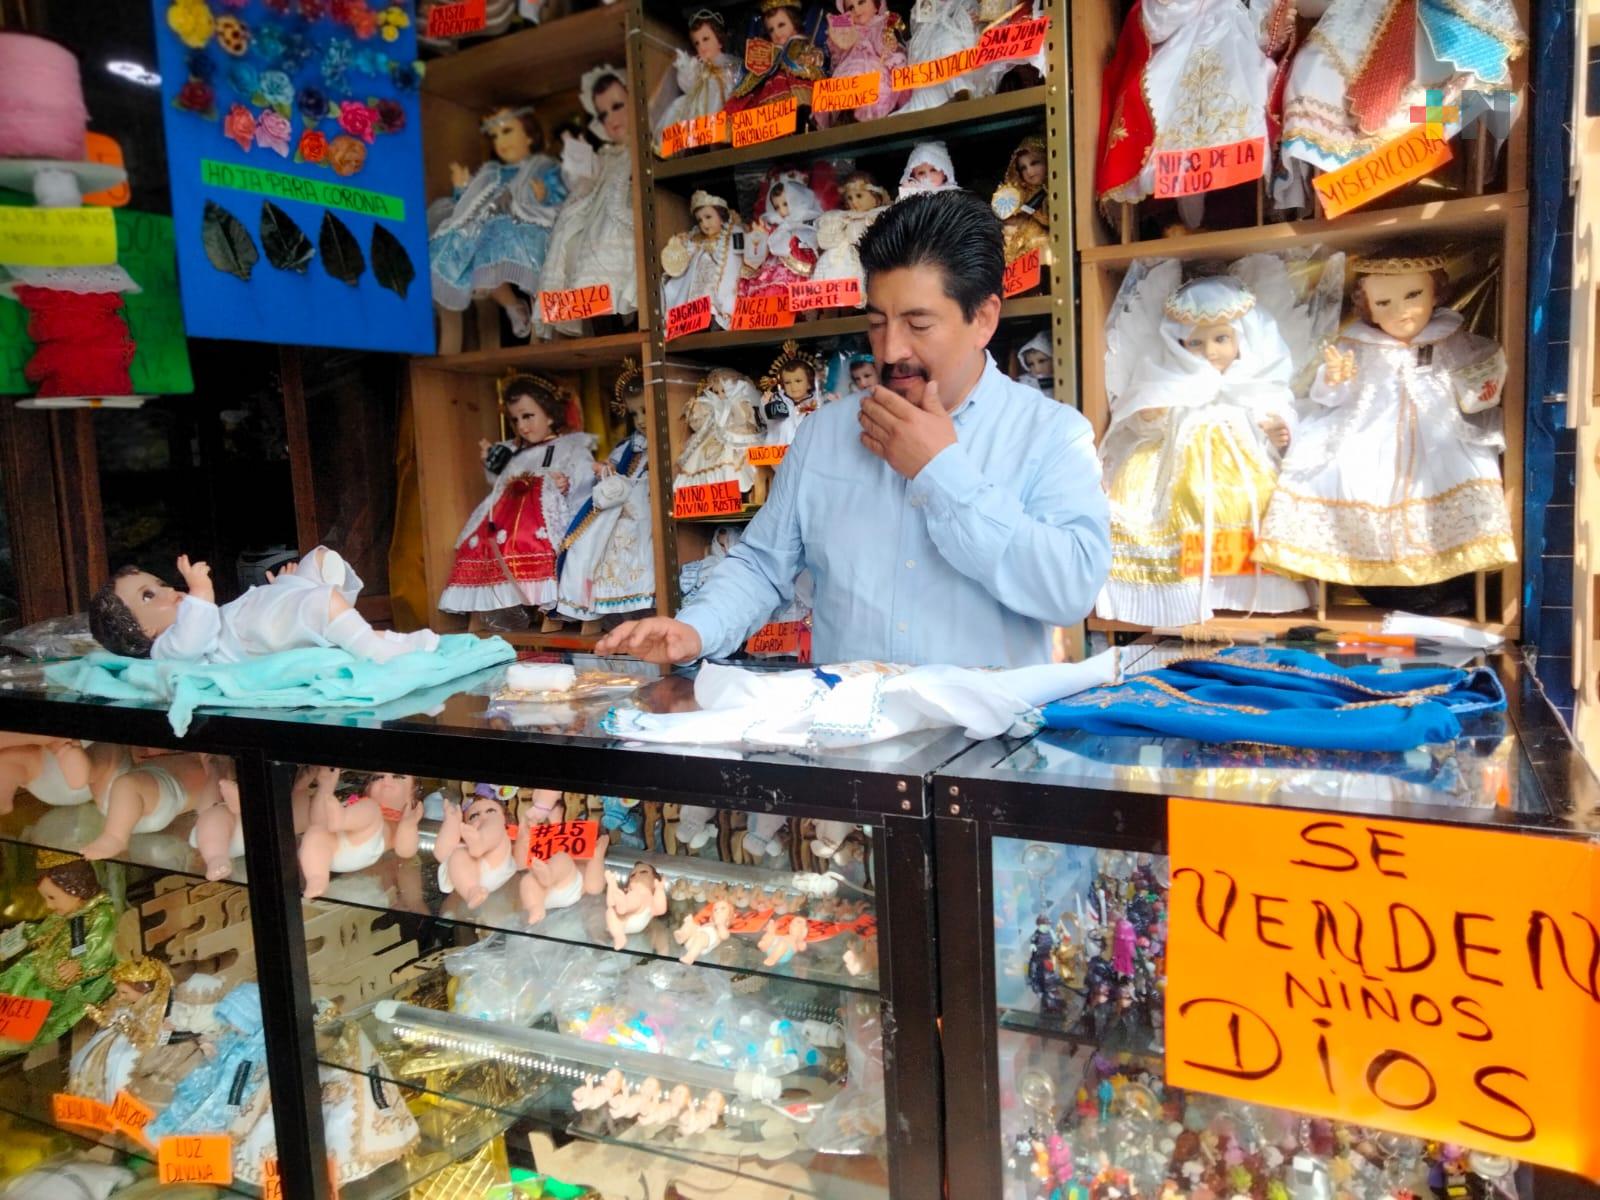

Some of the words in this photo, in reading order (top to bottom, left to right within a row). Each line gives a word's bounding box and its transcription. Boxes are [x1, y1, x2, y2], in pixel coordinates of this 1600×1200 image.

[981, 28, 1009, 48] SAN
[1011, 20, 1047, 42] JUAN
[976, 44, 1019, 65] PABLO
[893, 49, 979, 88] PRESENTACIO
[820, 76, 859, 94] MUEVE
[814, 89, 879, 110] CORAZONES
[733, 112, 753, 130] SAN
[757, 99, 796, 125] MIGUEL
[1209, 150, 1228, 168] DE
[1237, 144, 1255, 165] LA
[1160, 171, 1213, 195] SALUD
[265, 173, 319, 203] PARA
[324, 186, 390, 215] CORONA
[1022, 249, 1039, 274] LOS
[826, 282, 841, 293] DE
[845, 281, 860, 293] LA
[670, 297, 711, 324] SAGRADA
[735, 298, 769, 315] ANGEL
[777, 296, 790, 313] DE
[792, 294, 841, 310] SUERTE
[731, 316, 743, 329] LA
[749, 313, 779, 328] SALUD
[710, 482, 733, 501] DEL
[675, 502, 710, 517] DIVINO
[535, 822, 587, 838] #15
[530, 836, 587, 861] $130
[1289, 820, 1409, 880] SE
[1172, 867, 1600, 1003] VENDEN
[175, 1138, 204, 1159] LUZ
[165, 1163, 214, 1183] DIVINA
